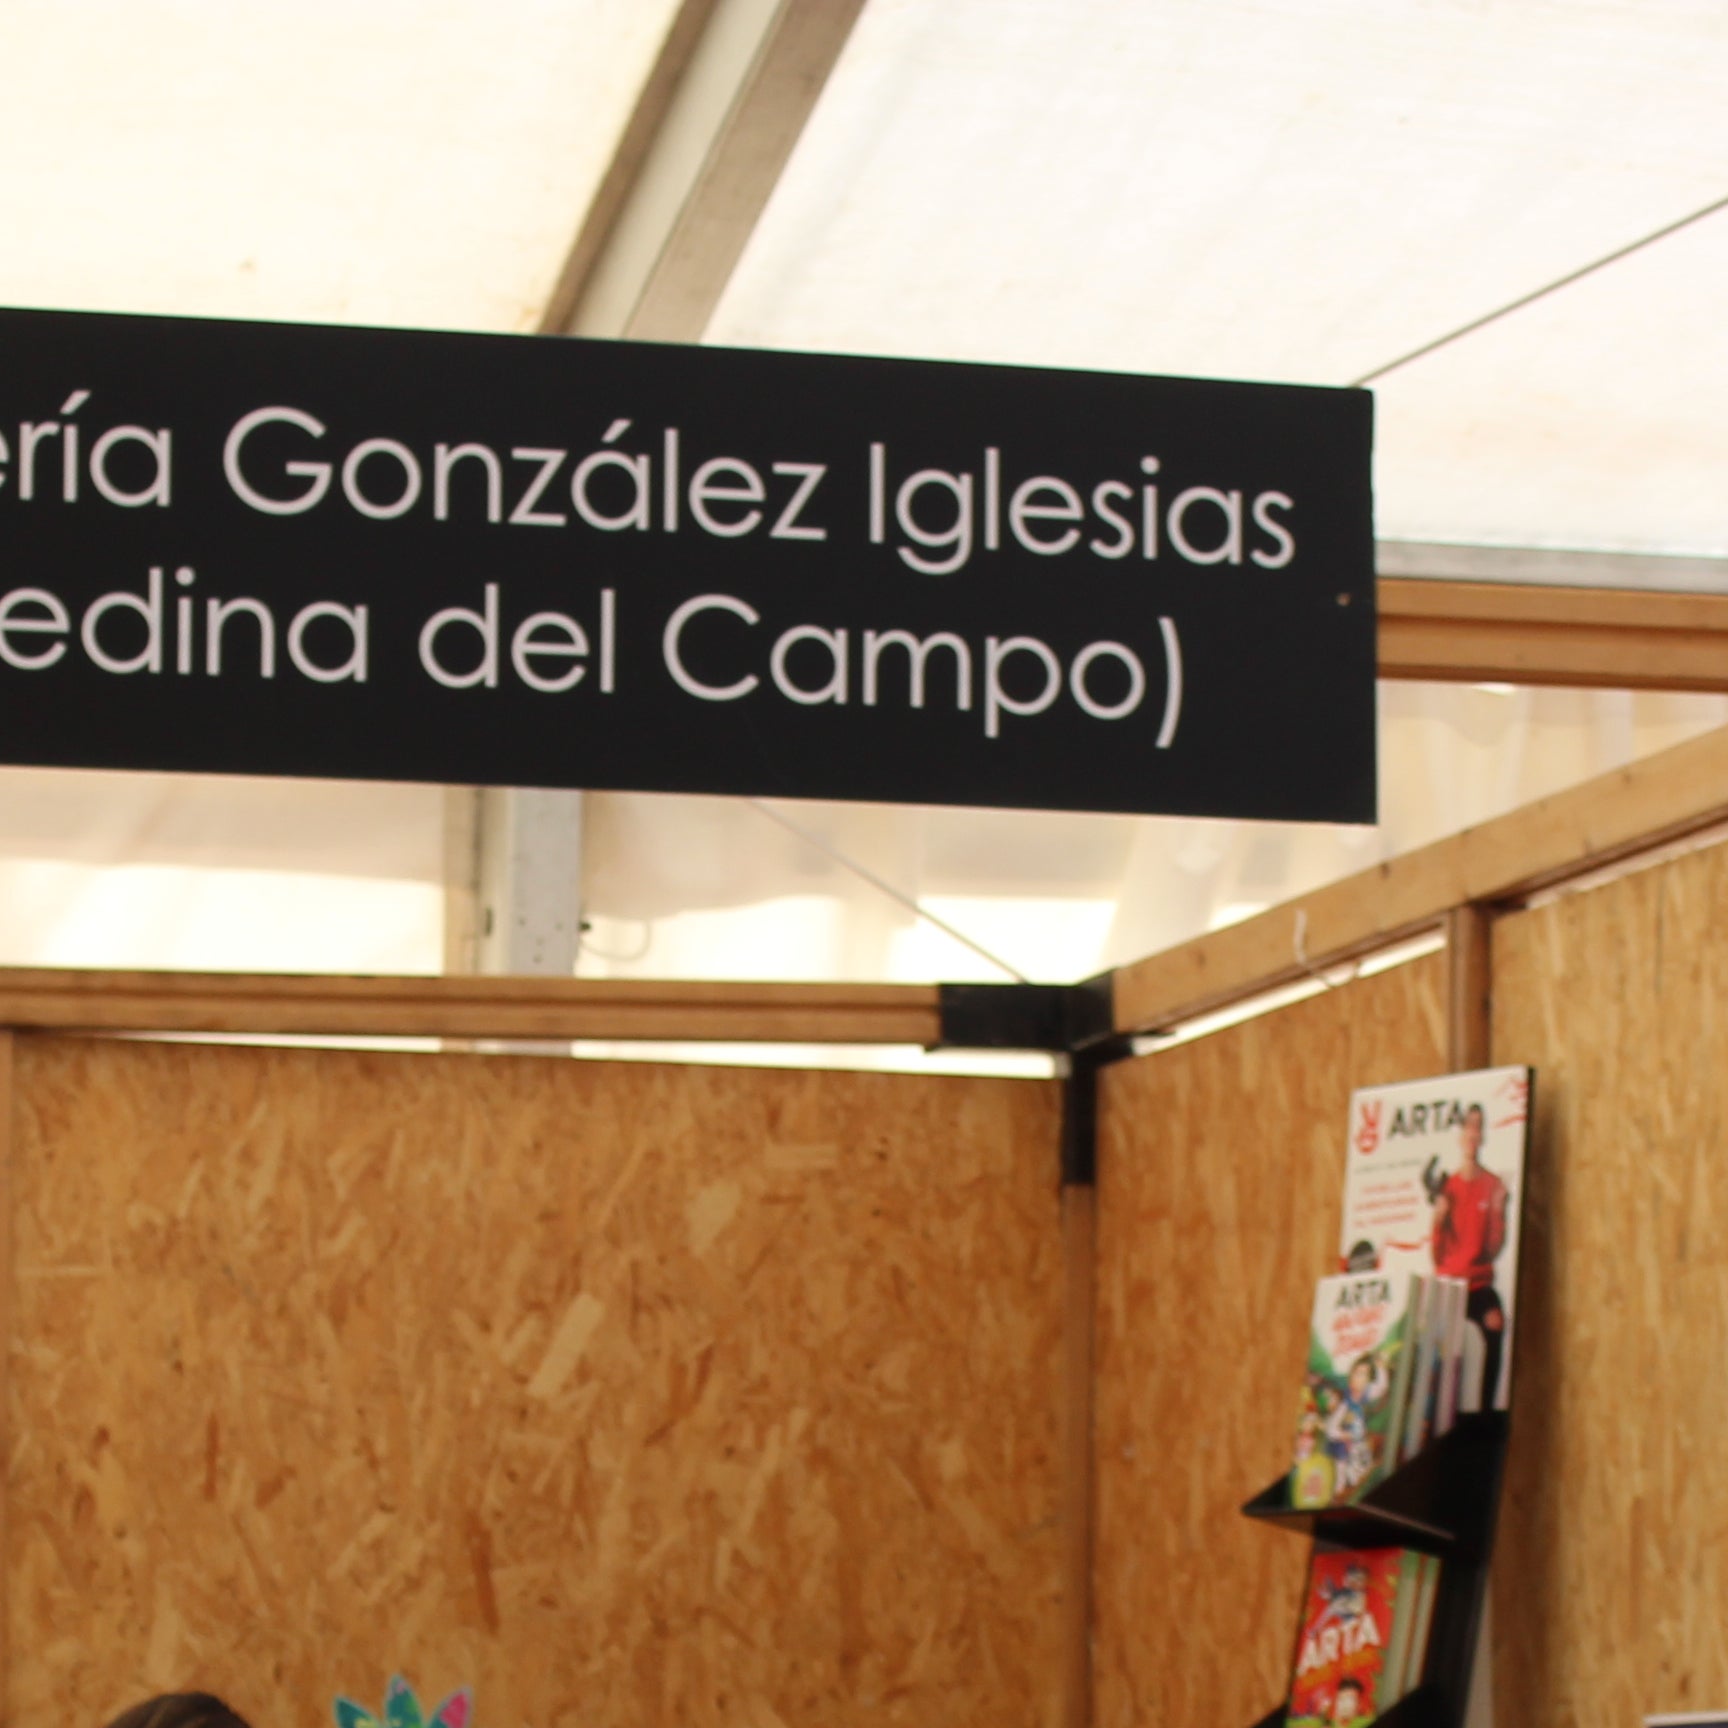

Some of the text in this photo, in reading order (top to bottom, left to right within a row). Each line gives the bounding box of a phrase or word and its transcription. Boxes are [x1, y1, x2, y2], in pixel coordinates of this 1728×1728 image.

[222, 405, 827, 543] González
[870, 442, 1296, 573] Iglesias
[418, 585, 616, 695] del
[663, 594, 1185, 748] Campo)
[1387, 1100, 1467, 1138] ARTA
